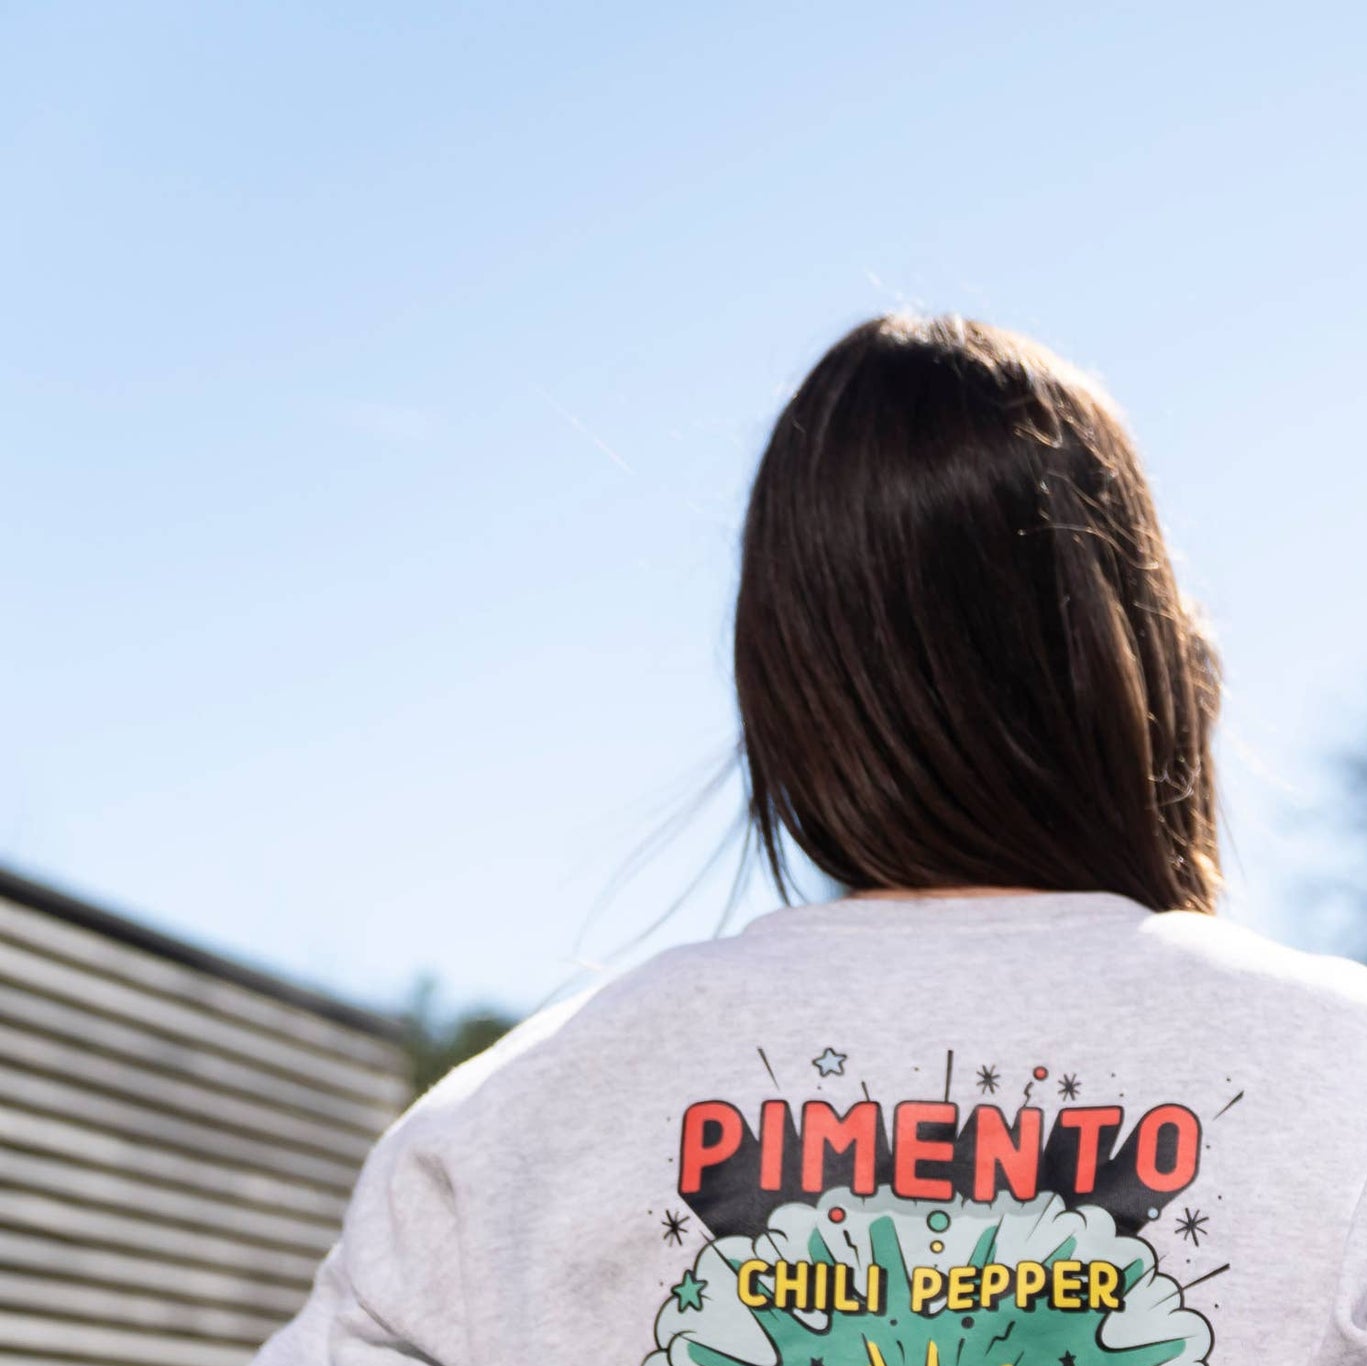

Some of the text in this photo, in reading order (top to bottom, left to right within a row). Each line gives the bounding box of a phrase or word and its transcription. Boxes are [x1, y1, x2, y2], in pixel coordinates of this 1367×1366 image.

[678, 1100, 1202, 1202] PIMENTO
[737, 1258, 1128, 1315] CHILI PEPPER
